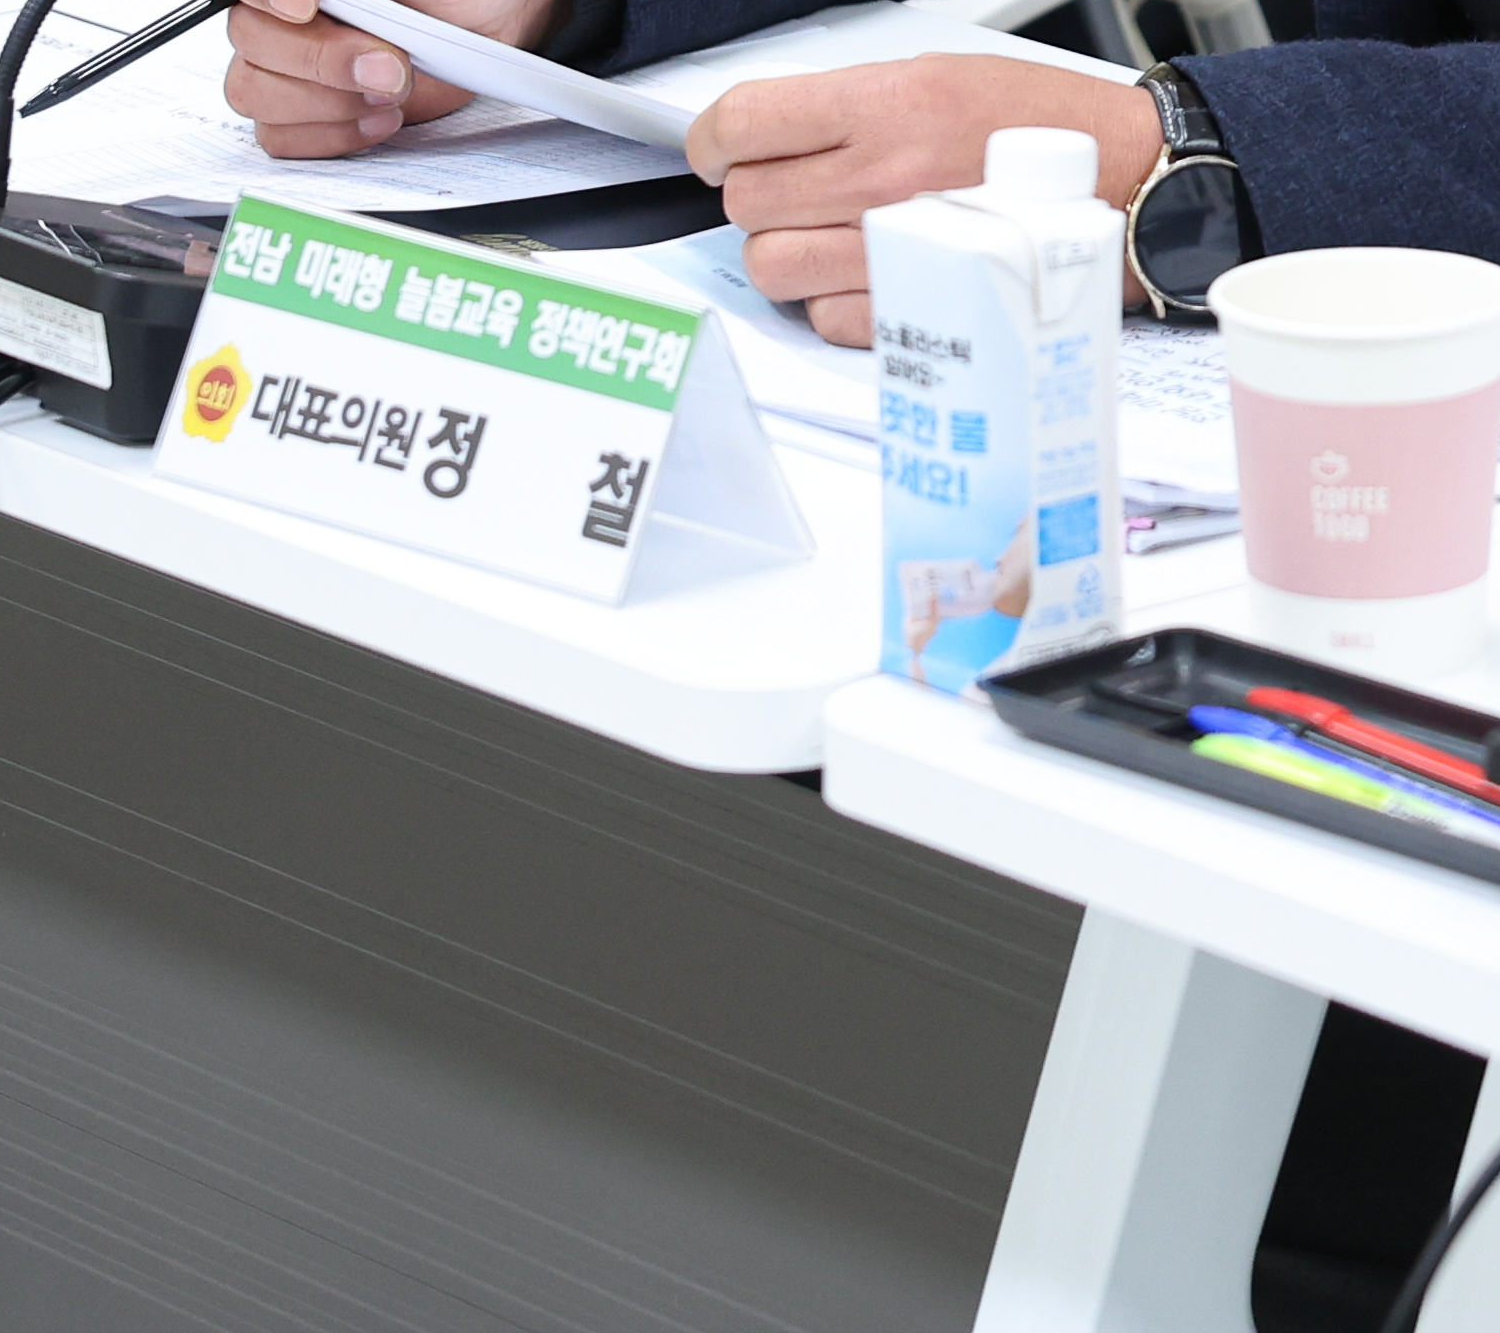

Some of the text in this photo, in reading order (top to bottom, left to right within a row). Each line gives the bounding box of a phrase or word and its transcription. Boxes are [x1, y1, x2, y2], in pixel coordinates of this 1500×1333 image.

[222, 219, 692, 394] 전남 미래형 늘봄교육 정책연구회
[250, 374, 651, 549] 대표의원 정 철
[1311, 485, 1389, 514] COFFEE
